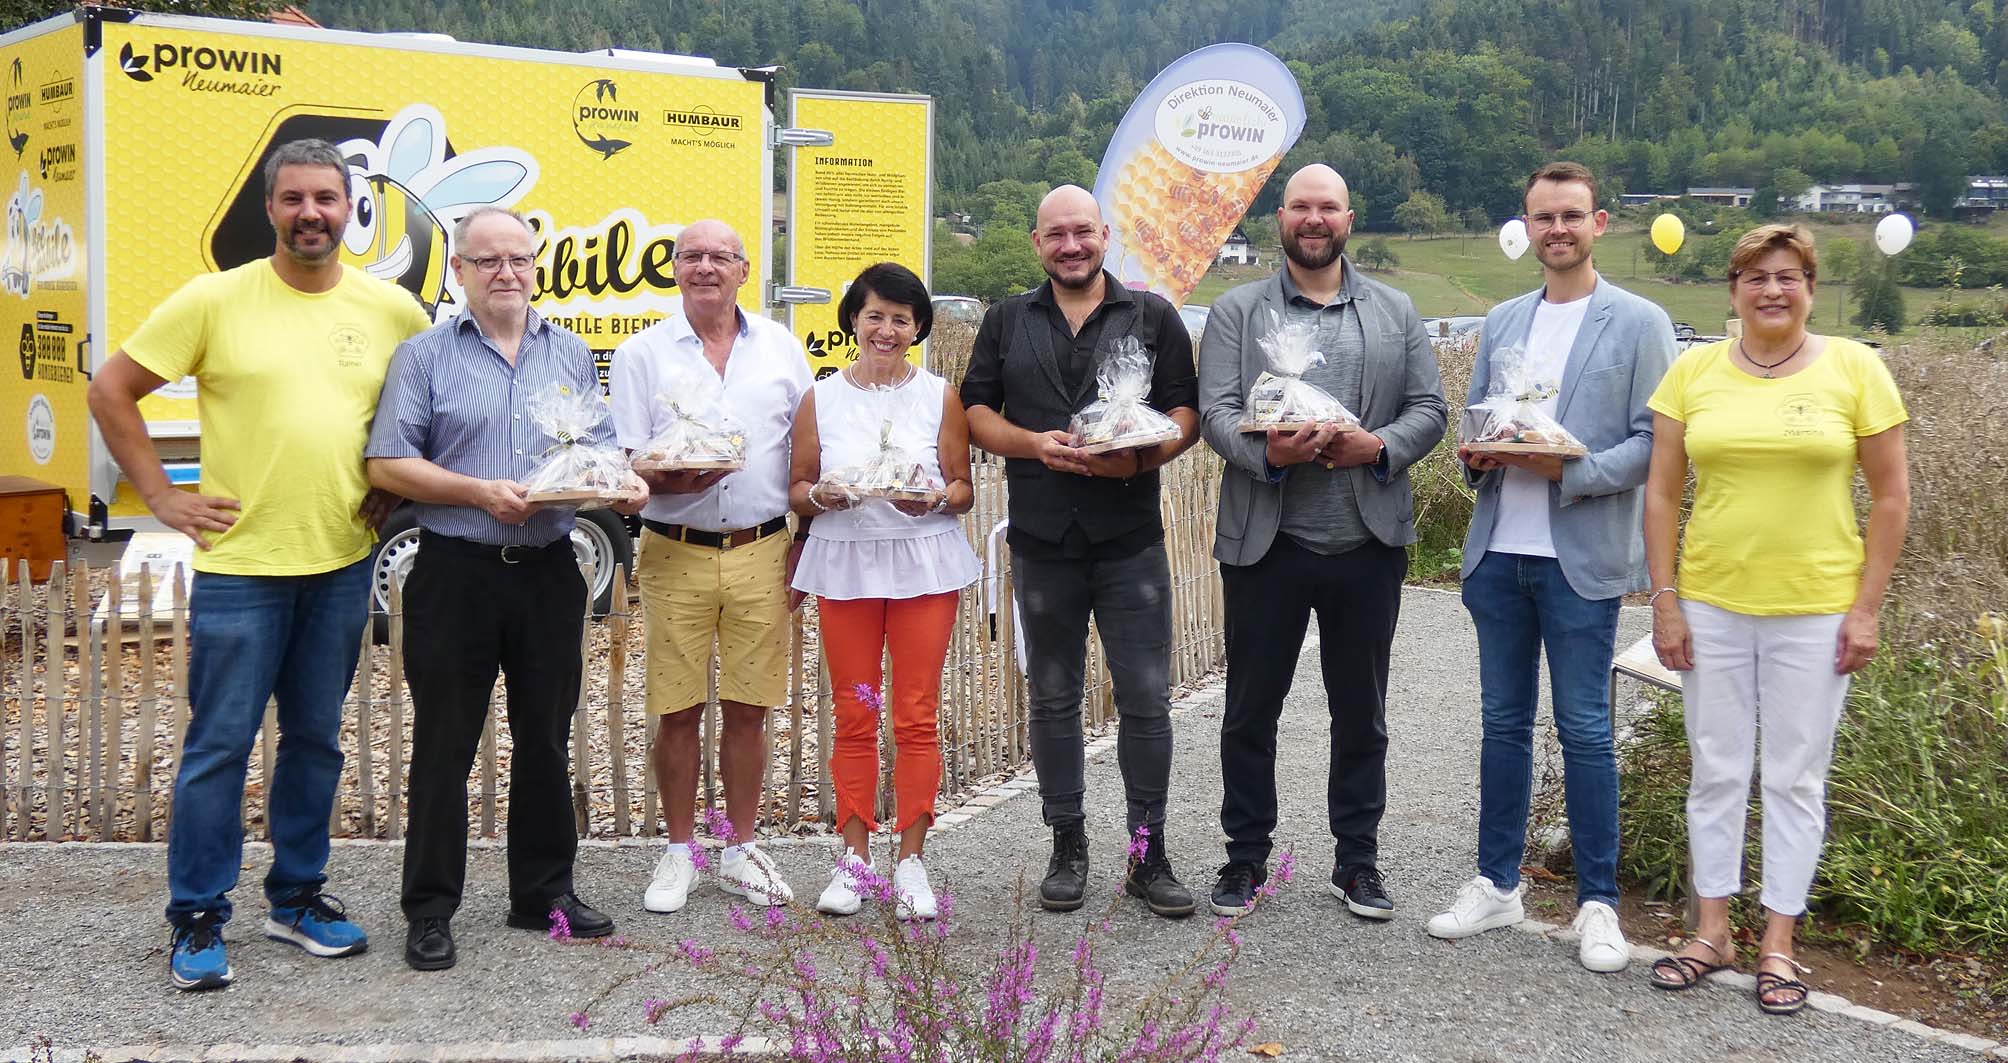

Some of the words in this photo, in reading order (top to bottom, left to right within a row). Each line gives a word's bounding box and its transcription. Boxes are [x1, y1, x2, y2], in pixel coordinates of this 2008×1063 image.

[41, 82, 73, 102] HUMBAUR
[182, 70, 282, 97] Neumaier
[1167, 84, 1224, 110] Direktion
[1228, 85, 1279, 123] Neumaier
[667, 112, 740, 128] HUMBAUR
[670, 138, 702, 147] MACHT'S
[815, 156, 873, 167] INFORMATION
[543, 316, 602, 334] OBILE
